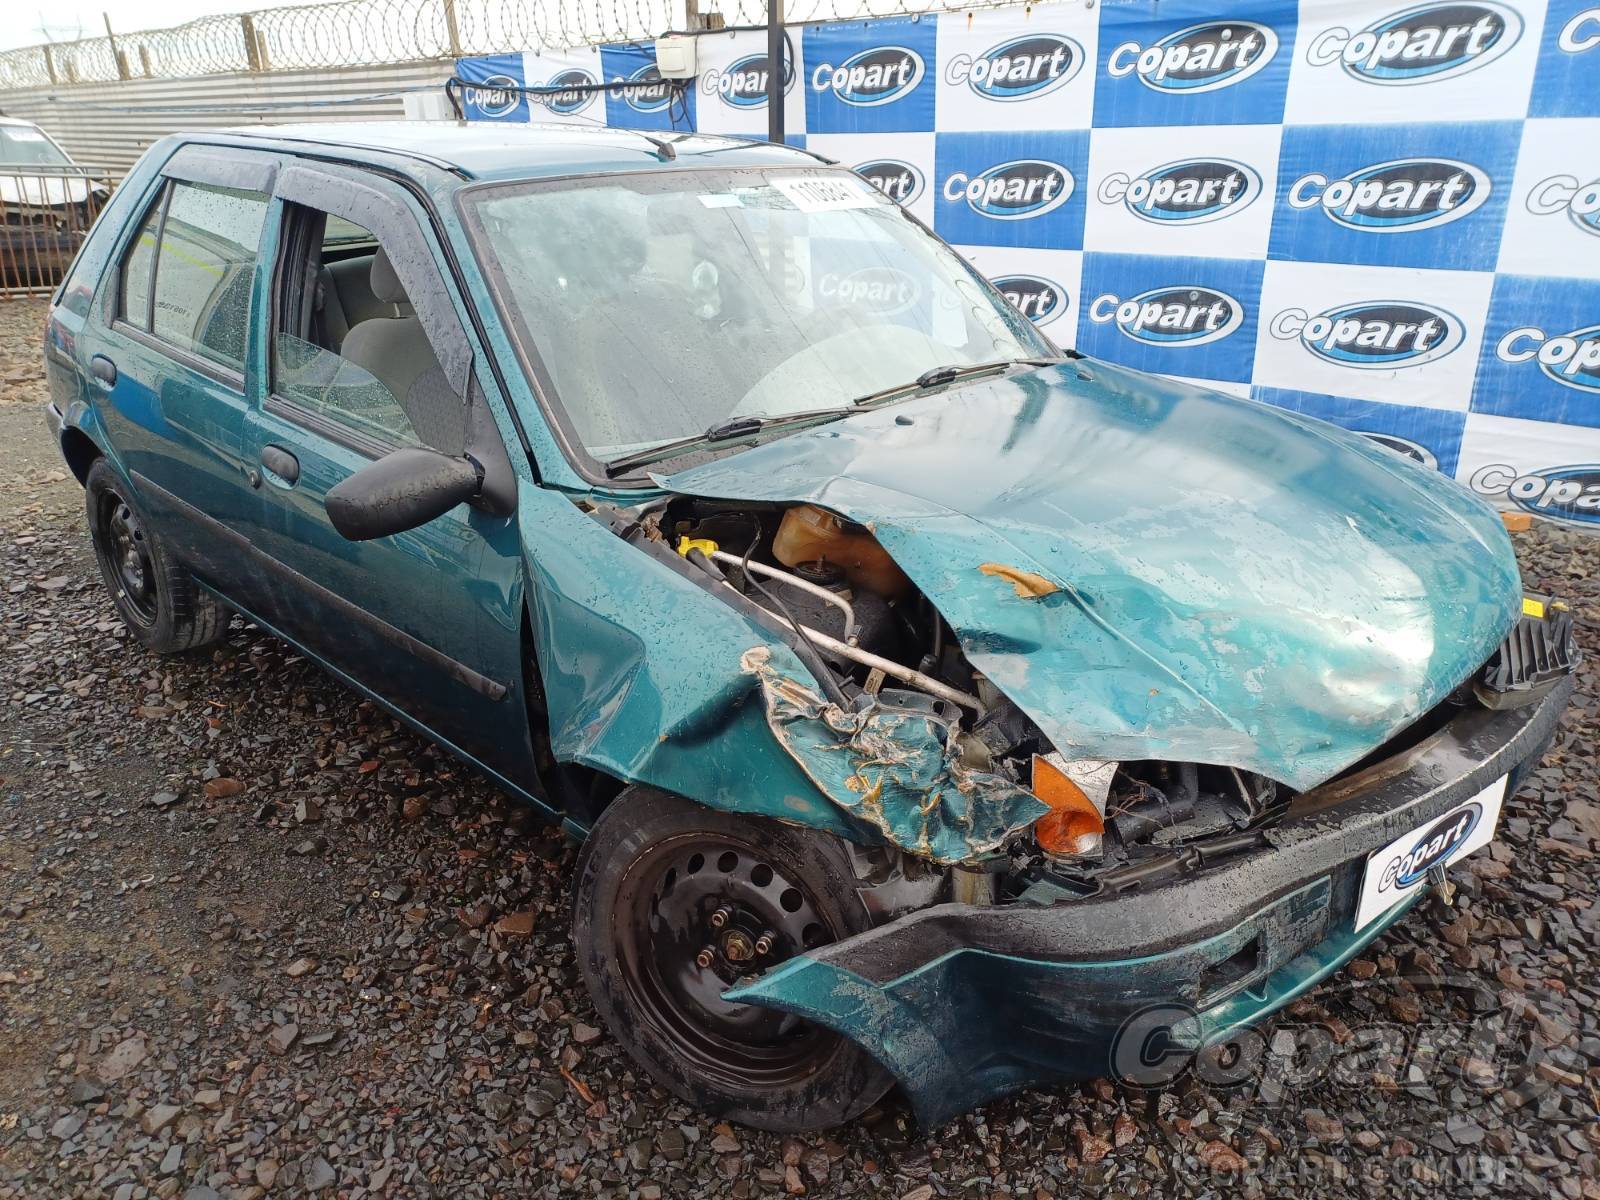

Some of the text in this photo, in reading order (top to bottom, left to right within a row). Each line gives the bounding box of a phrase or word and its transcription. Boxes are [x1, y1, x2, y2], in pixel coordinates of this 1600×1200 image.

[1107, 31, 1259, 80] Copart
[1306, 13, 1494, 70] Copart
[702, 68, 768, 97] Copar
[812, 57, 911, 95] Copart
[945, 46, 1066, 88] Copart
[943, 171, 1060, 206] Copart
[1098, 171, 1243, 210] Copart
[1288, 172, 1468, 216] Copart
[1089, 293, 1226, 332] Copart
[1270, 308, 1440, 351] Copart
[1378, 814, 1468, 893] Copart
